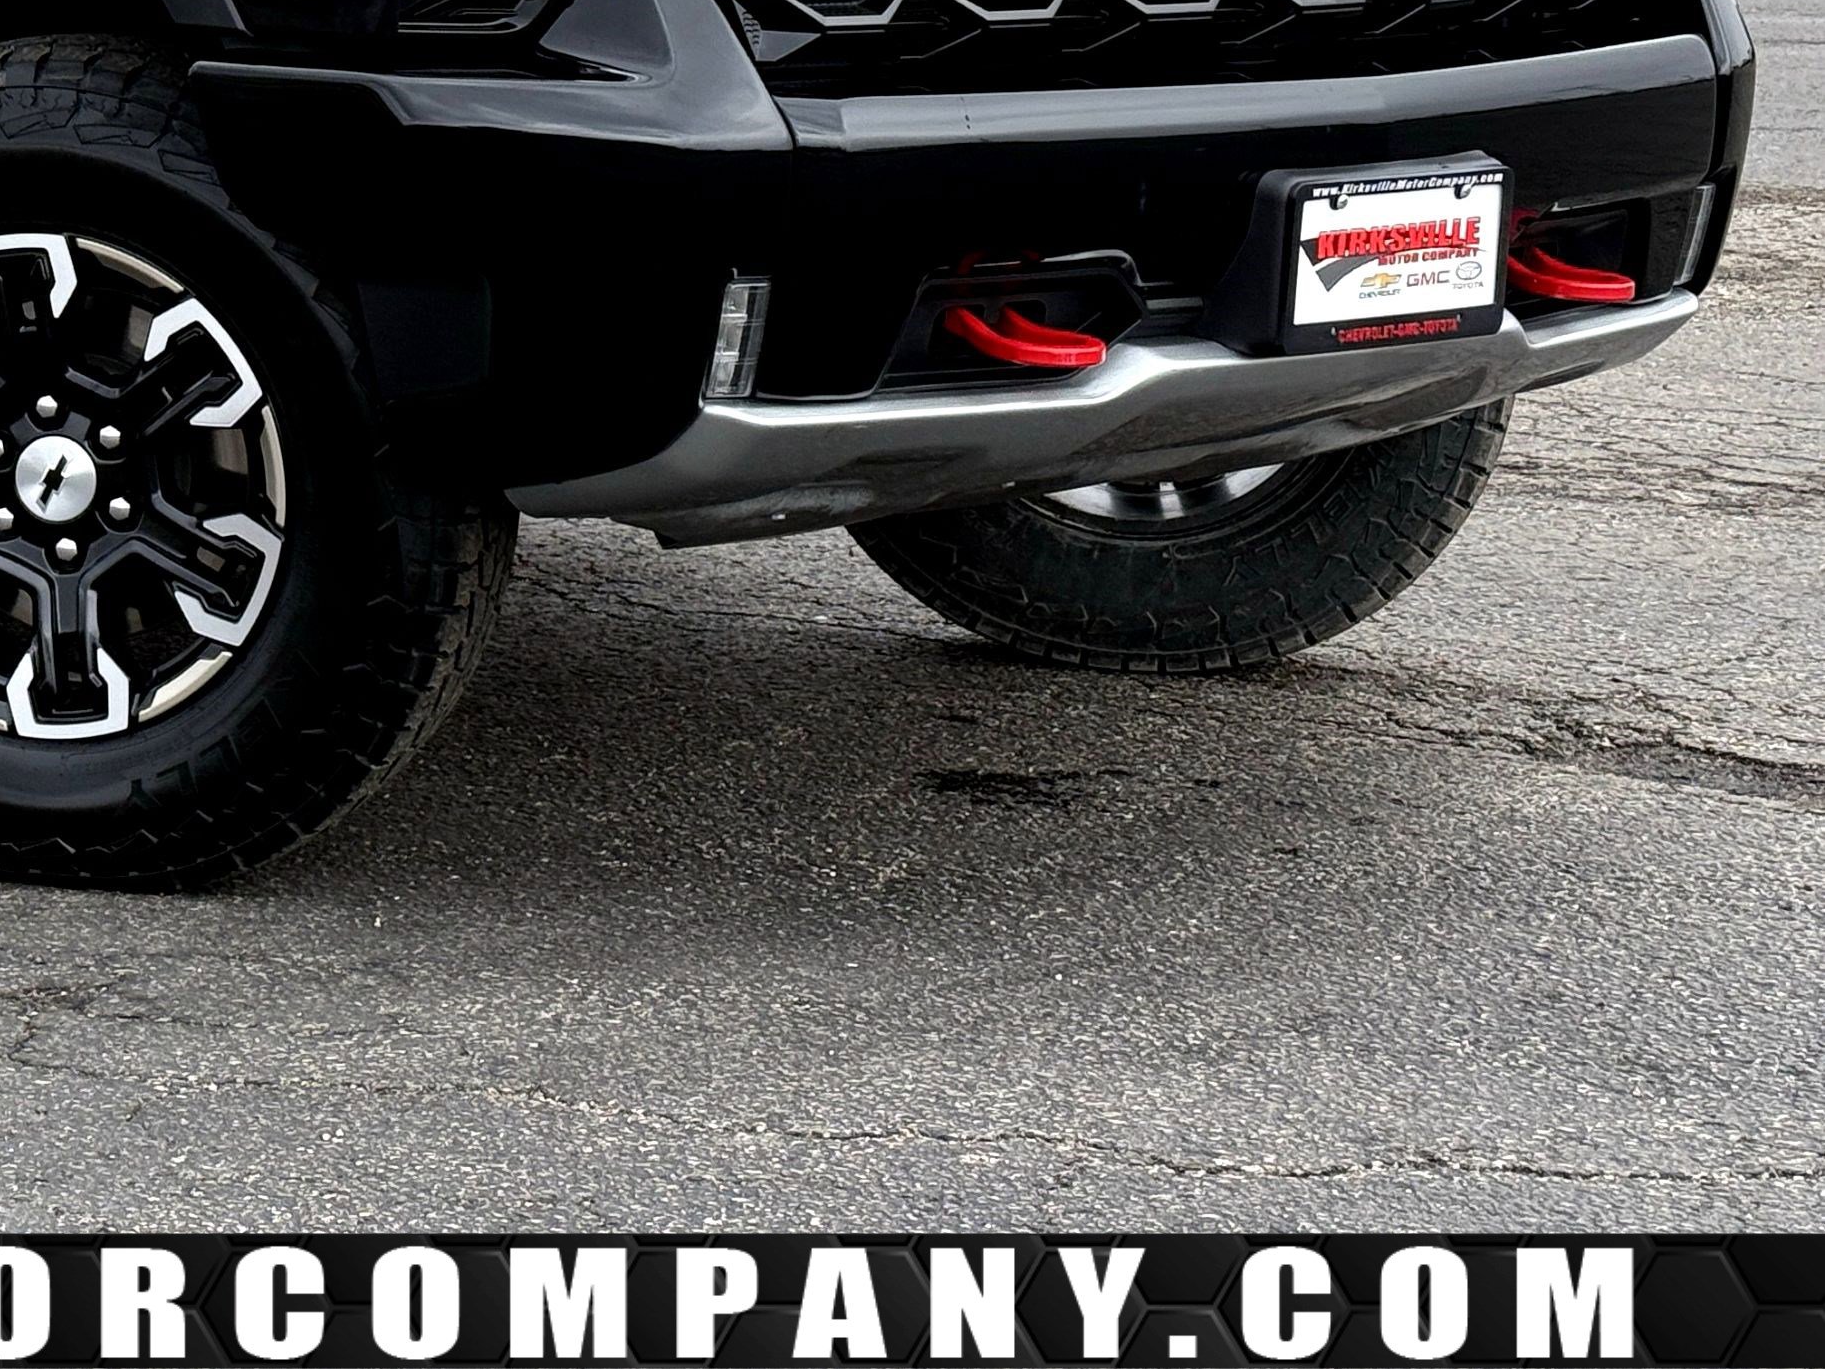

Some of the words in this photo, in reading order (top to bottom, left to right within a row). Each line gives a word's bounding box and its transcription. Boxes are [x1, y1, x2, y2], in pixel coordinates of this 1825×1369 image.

[1317, 217, 1481, 259] KIRKSVILLE
[1378, 252, 1420, 267] MOTOR
[1421, 247, 1480, 262] COMPANY
[1406, 269, 1451, 288] GMC
